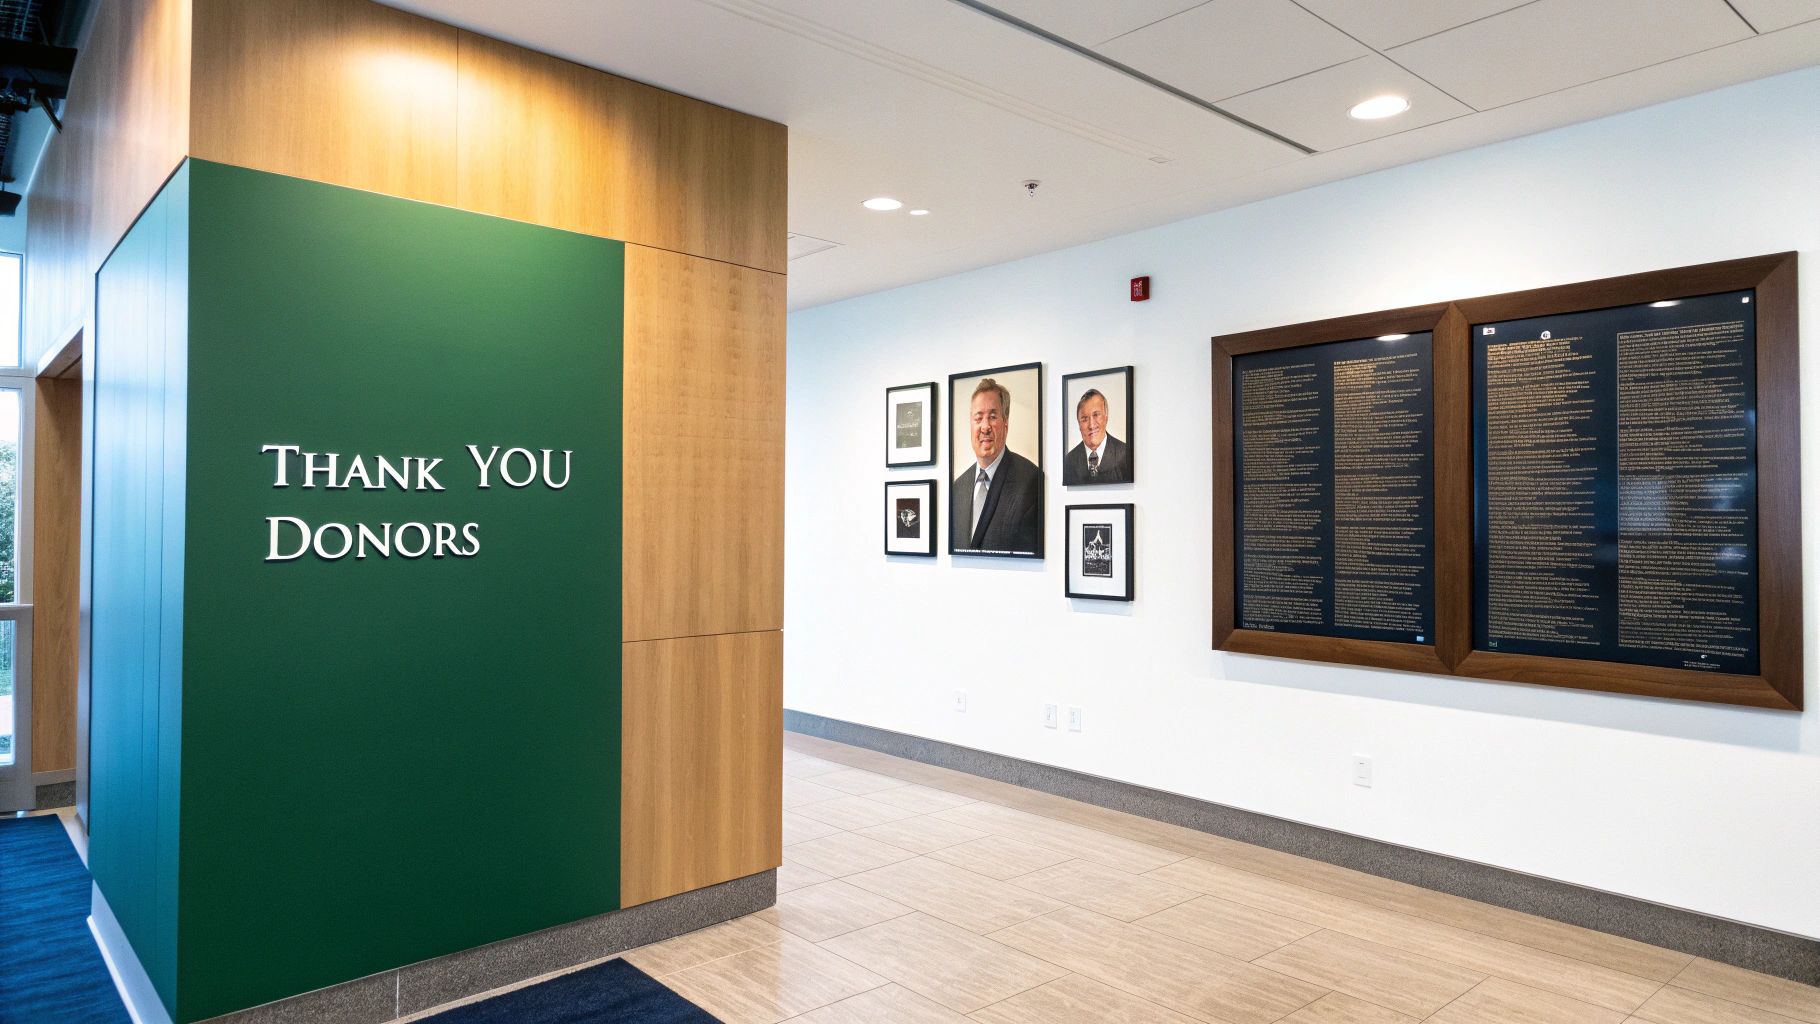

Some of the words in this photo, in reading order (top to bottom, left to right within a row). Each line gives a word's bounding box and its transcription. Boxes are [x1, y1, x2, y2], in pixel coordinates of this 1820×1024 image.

[261, 444, 445, 490] THANK
[465, 444, 574, 489] YOU
[265, 516, 480, 561] DONORS
